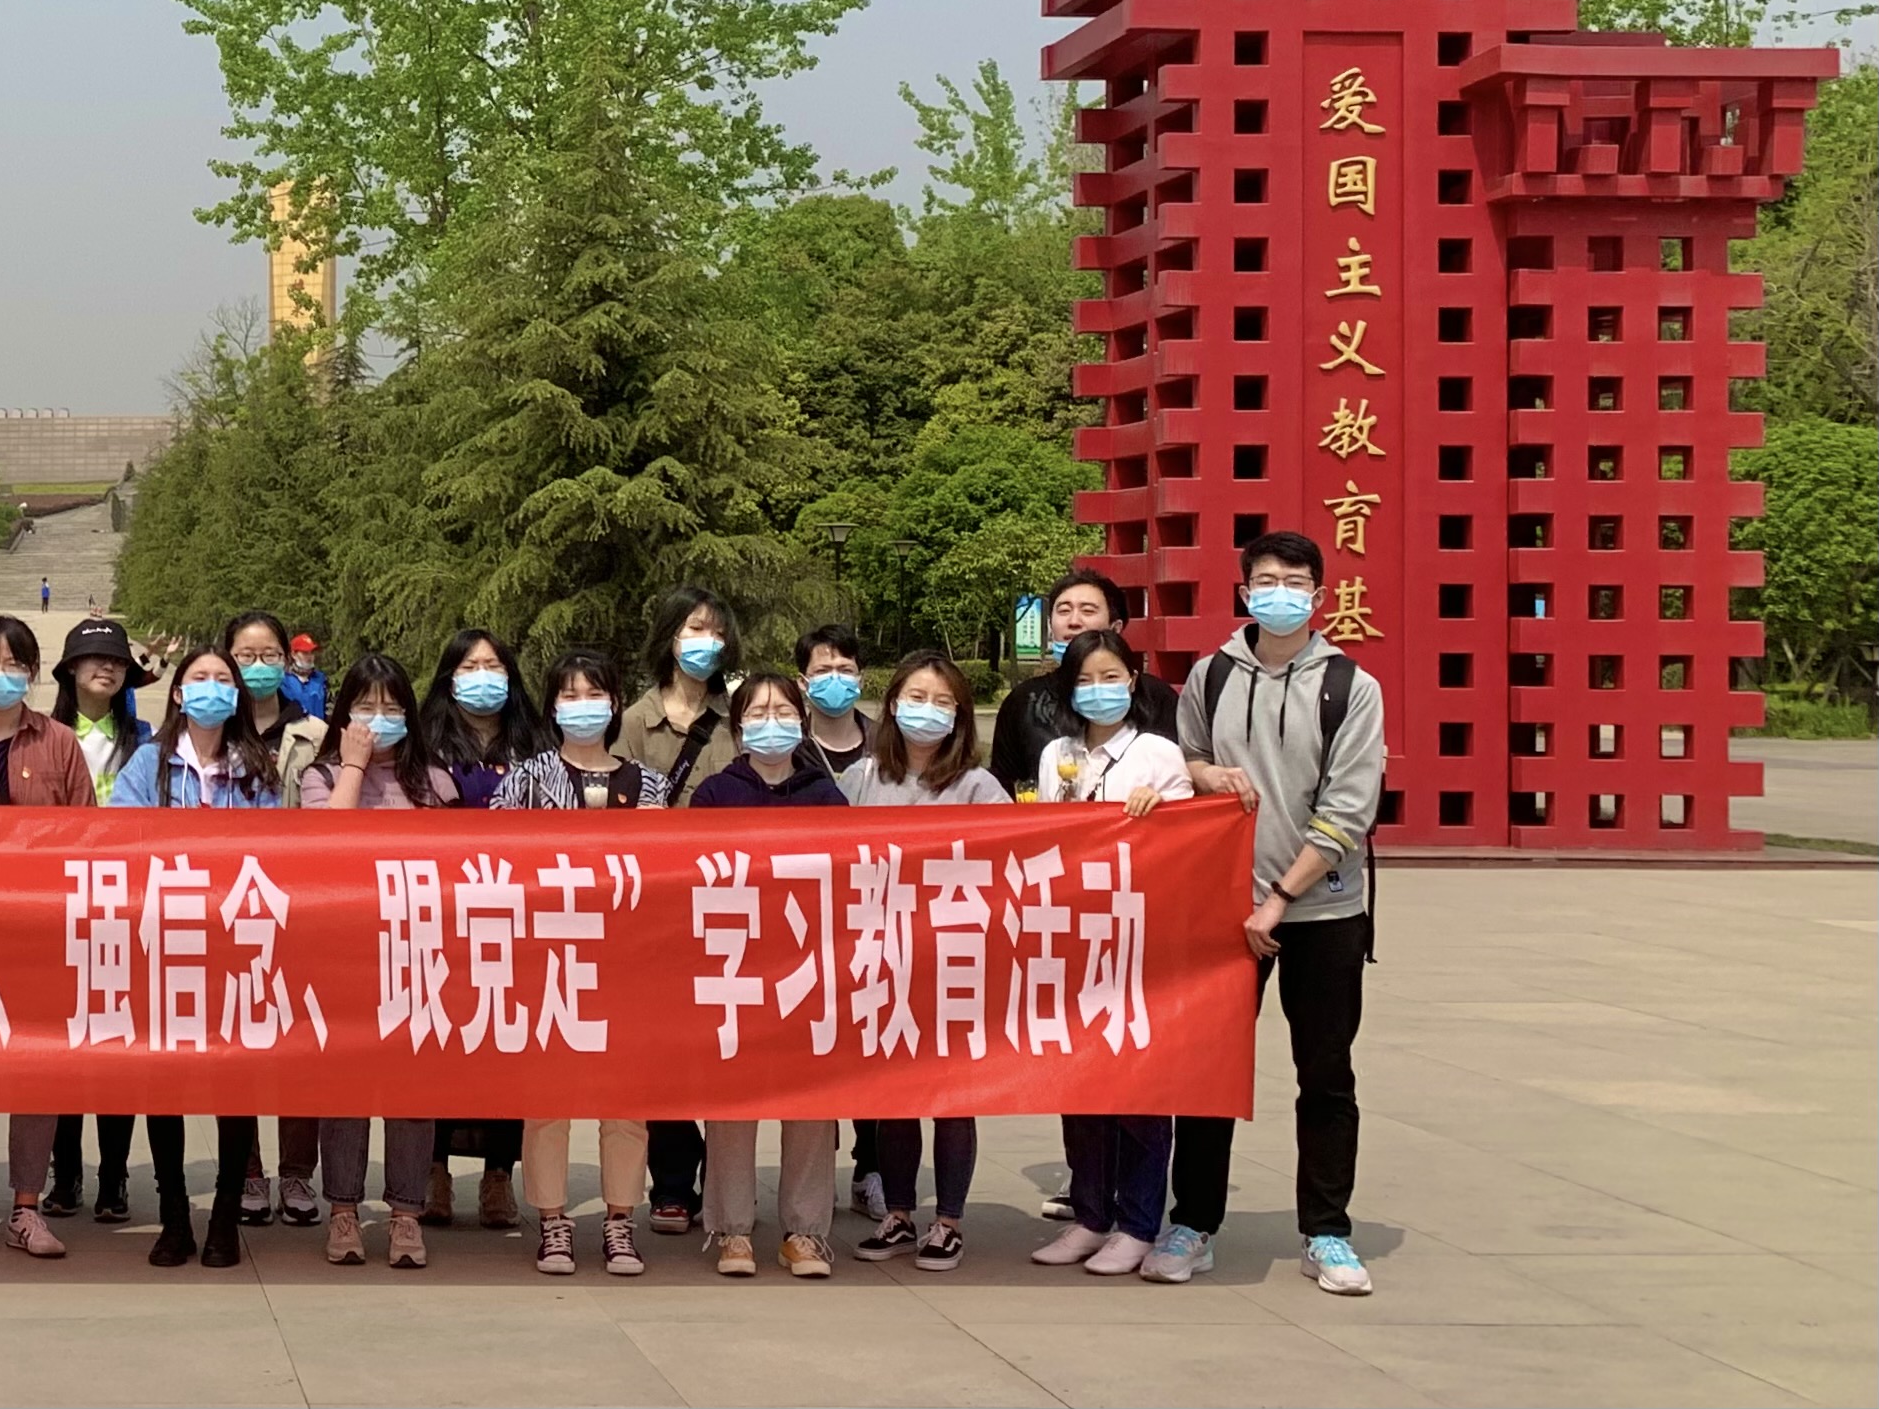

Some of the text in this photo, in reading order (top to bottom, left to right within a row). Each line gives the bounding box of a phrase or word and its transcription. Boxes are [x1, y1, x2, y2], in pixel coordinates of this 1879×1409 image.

[1317, 66, 1387, 644] 爱国主义教育基
